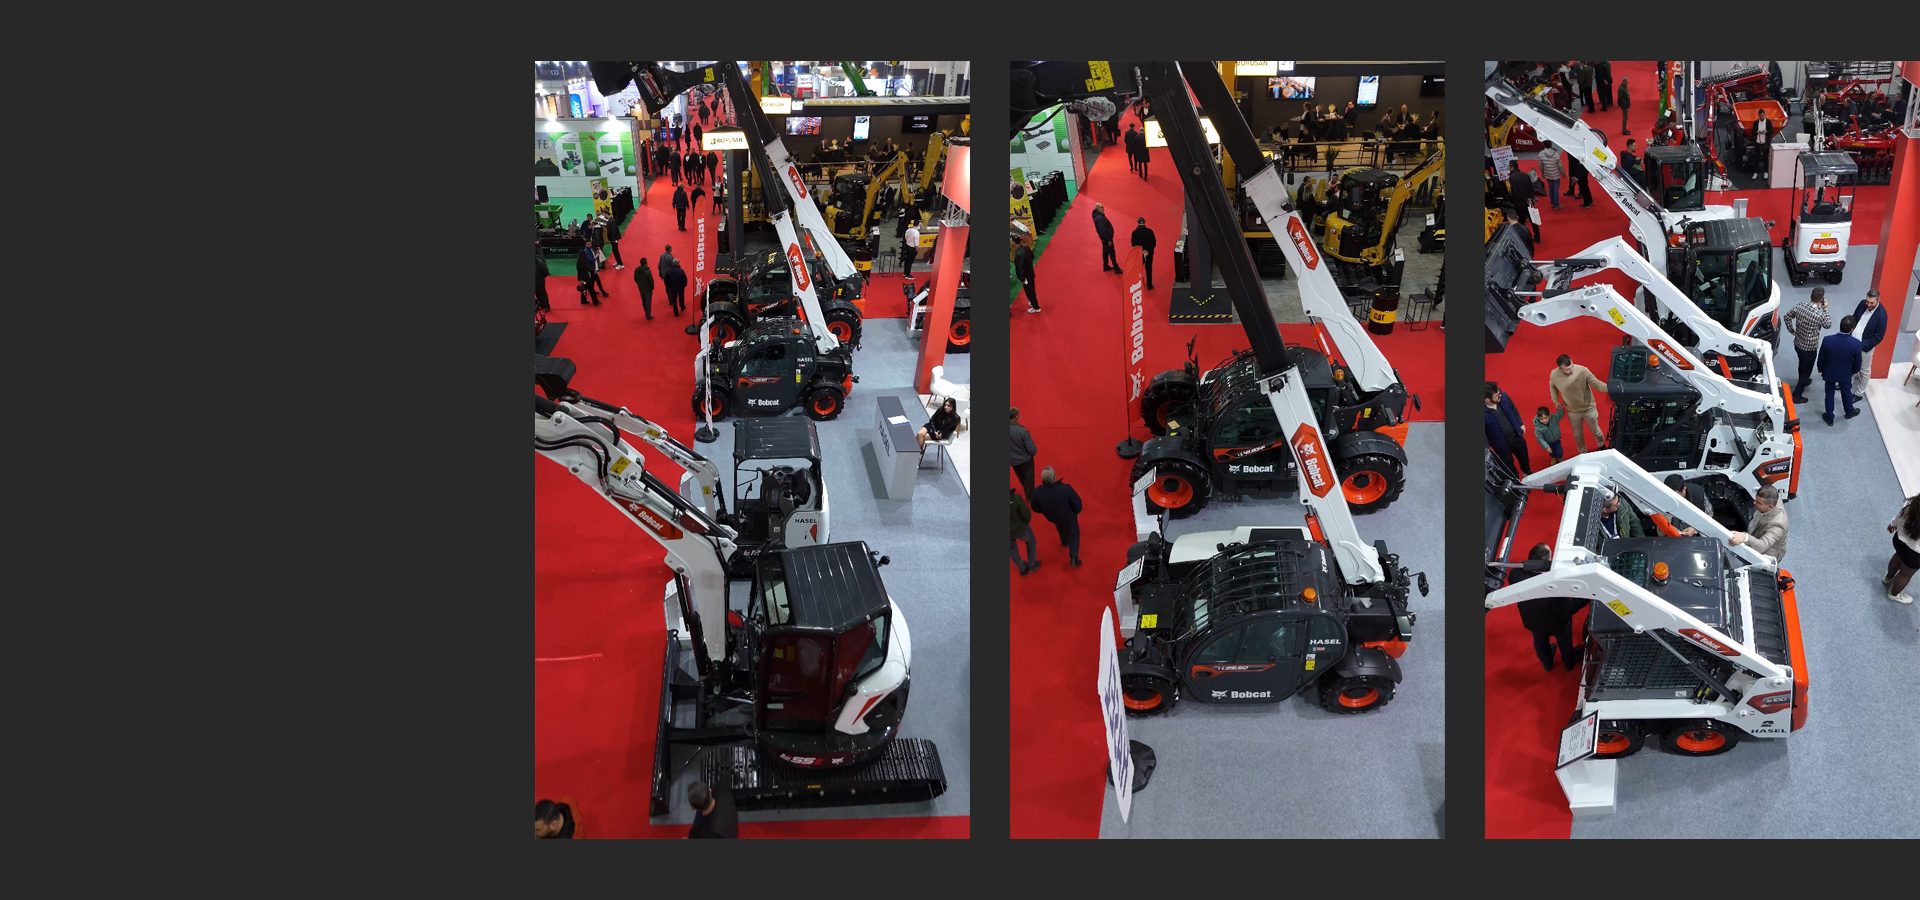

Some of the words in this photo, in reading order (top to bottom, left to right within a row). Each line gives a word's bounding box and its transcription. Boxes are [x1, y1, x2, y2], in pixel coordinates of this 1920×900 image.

[1622, 197, 1641, 216] Bobcat
[696, 217, 705, 271] Bobcat
[1298, 241, 1314, 264] Bobcat
[1820, 242, 1837, 250] Bobcat
[793, 264, 806, 285] Bobcat
[1129, 280, 1144, 365] Bobcat
[1663, 349, 1681, 364] Bobcat
[1243, 464, 1274, 473] Bobcat
[1304, 458, 1326, 489] Bobcat
[637, 509, 664, 532] Bobcat
[1702, 636, 1721, 650] Bobcat
[1231, 690, 1272, 699] Bobcat
